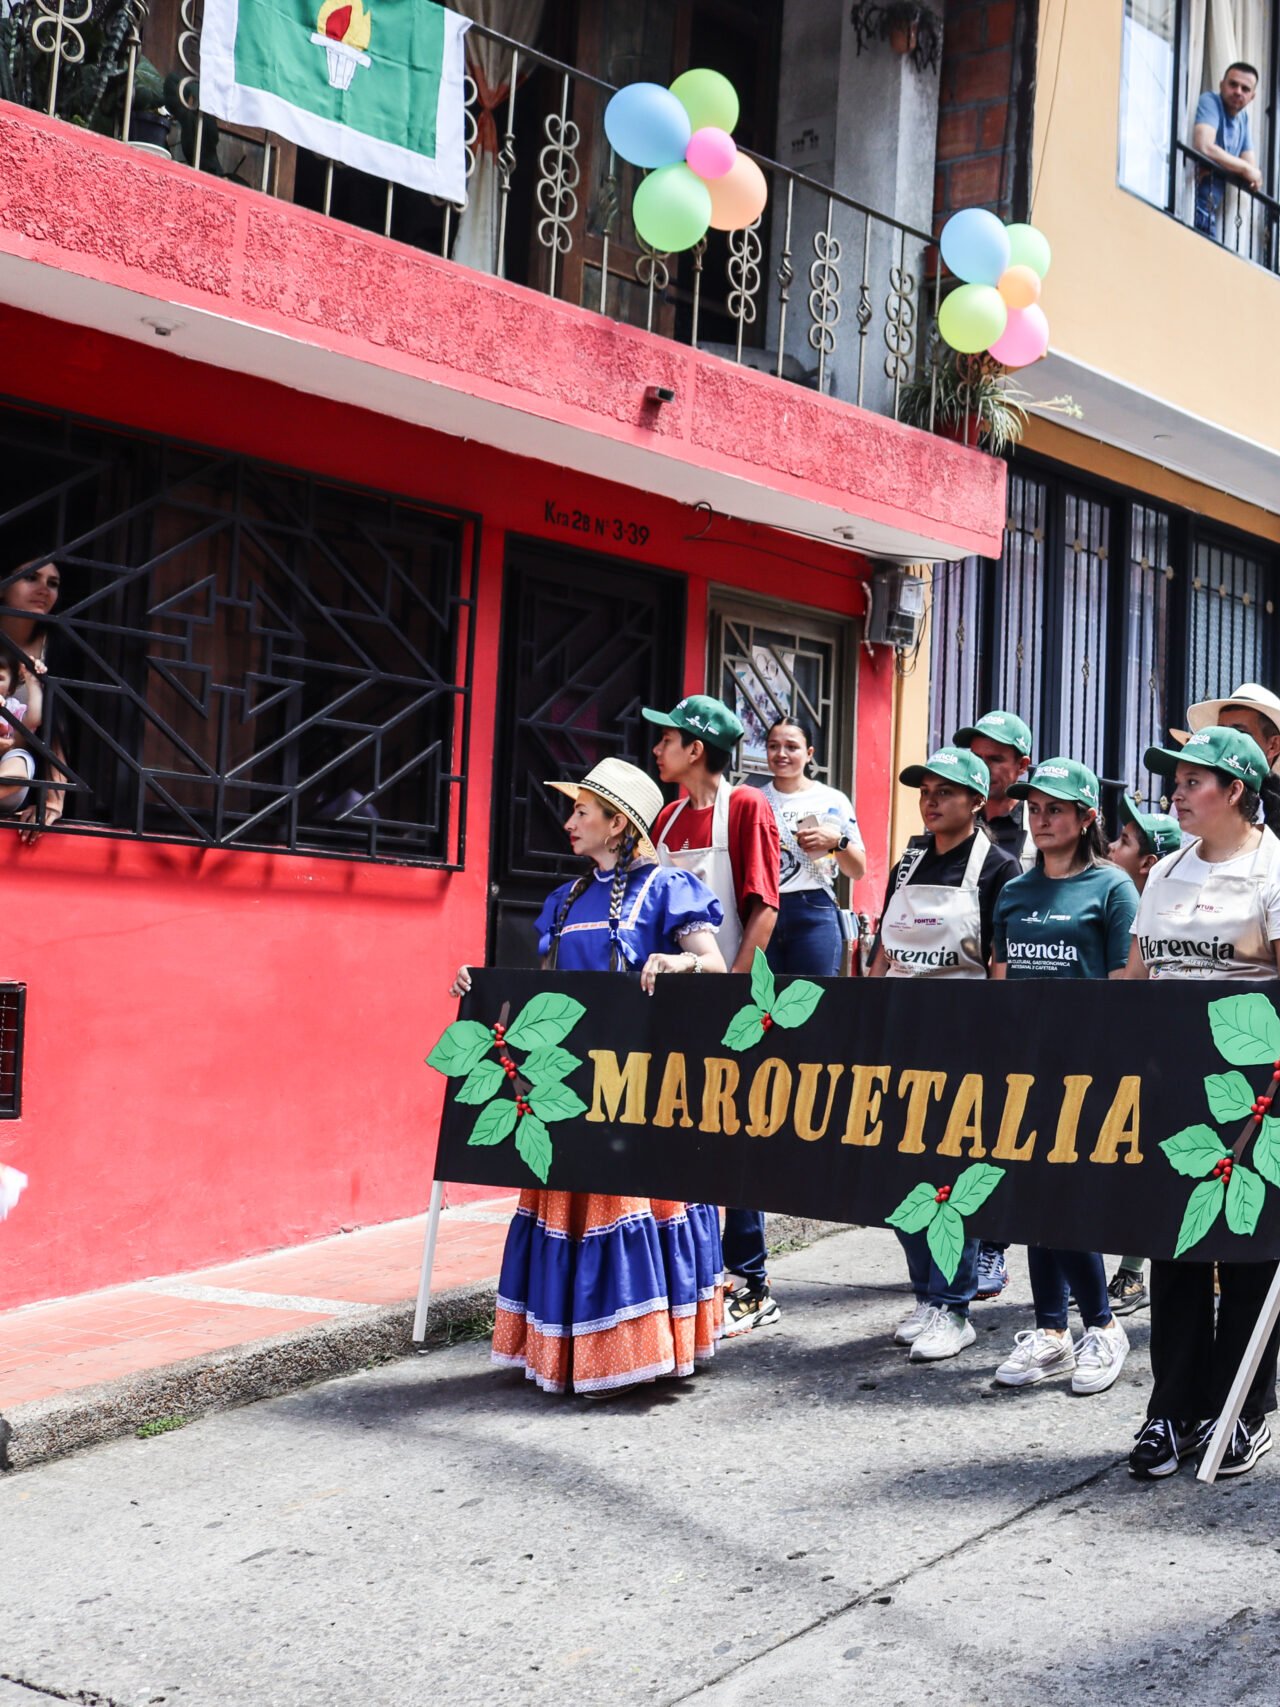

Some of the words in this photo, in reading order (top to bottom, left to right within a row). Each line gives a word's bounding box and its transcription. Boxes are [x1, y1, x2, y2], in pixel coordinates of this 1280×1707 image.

[544, 499, 569, 526] Kra
[612, 519, 650, 546] 3-39
[1006, 938, 1078, 961] erencia
[1139, 935, 1235, 961] Herencia
[584, 1048, 1145, 1166] MARQUETALIA
